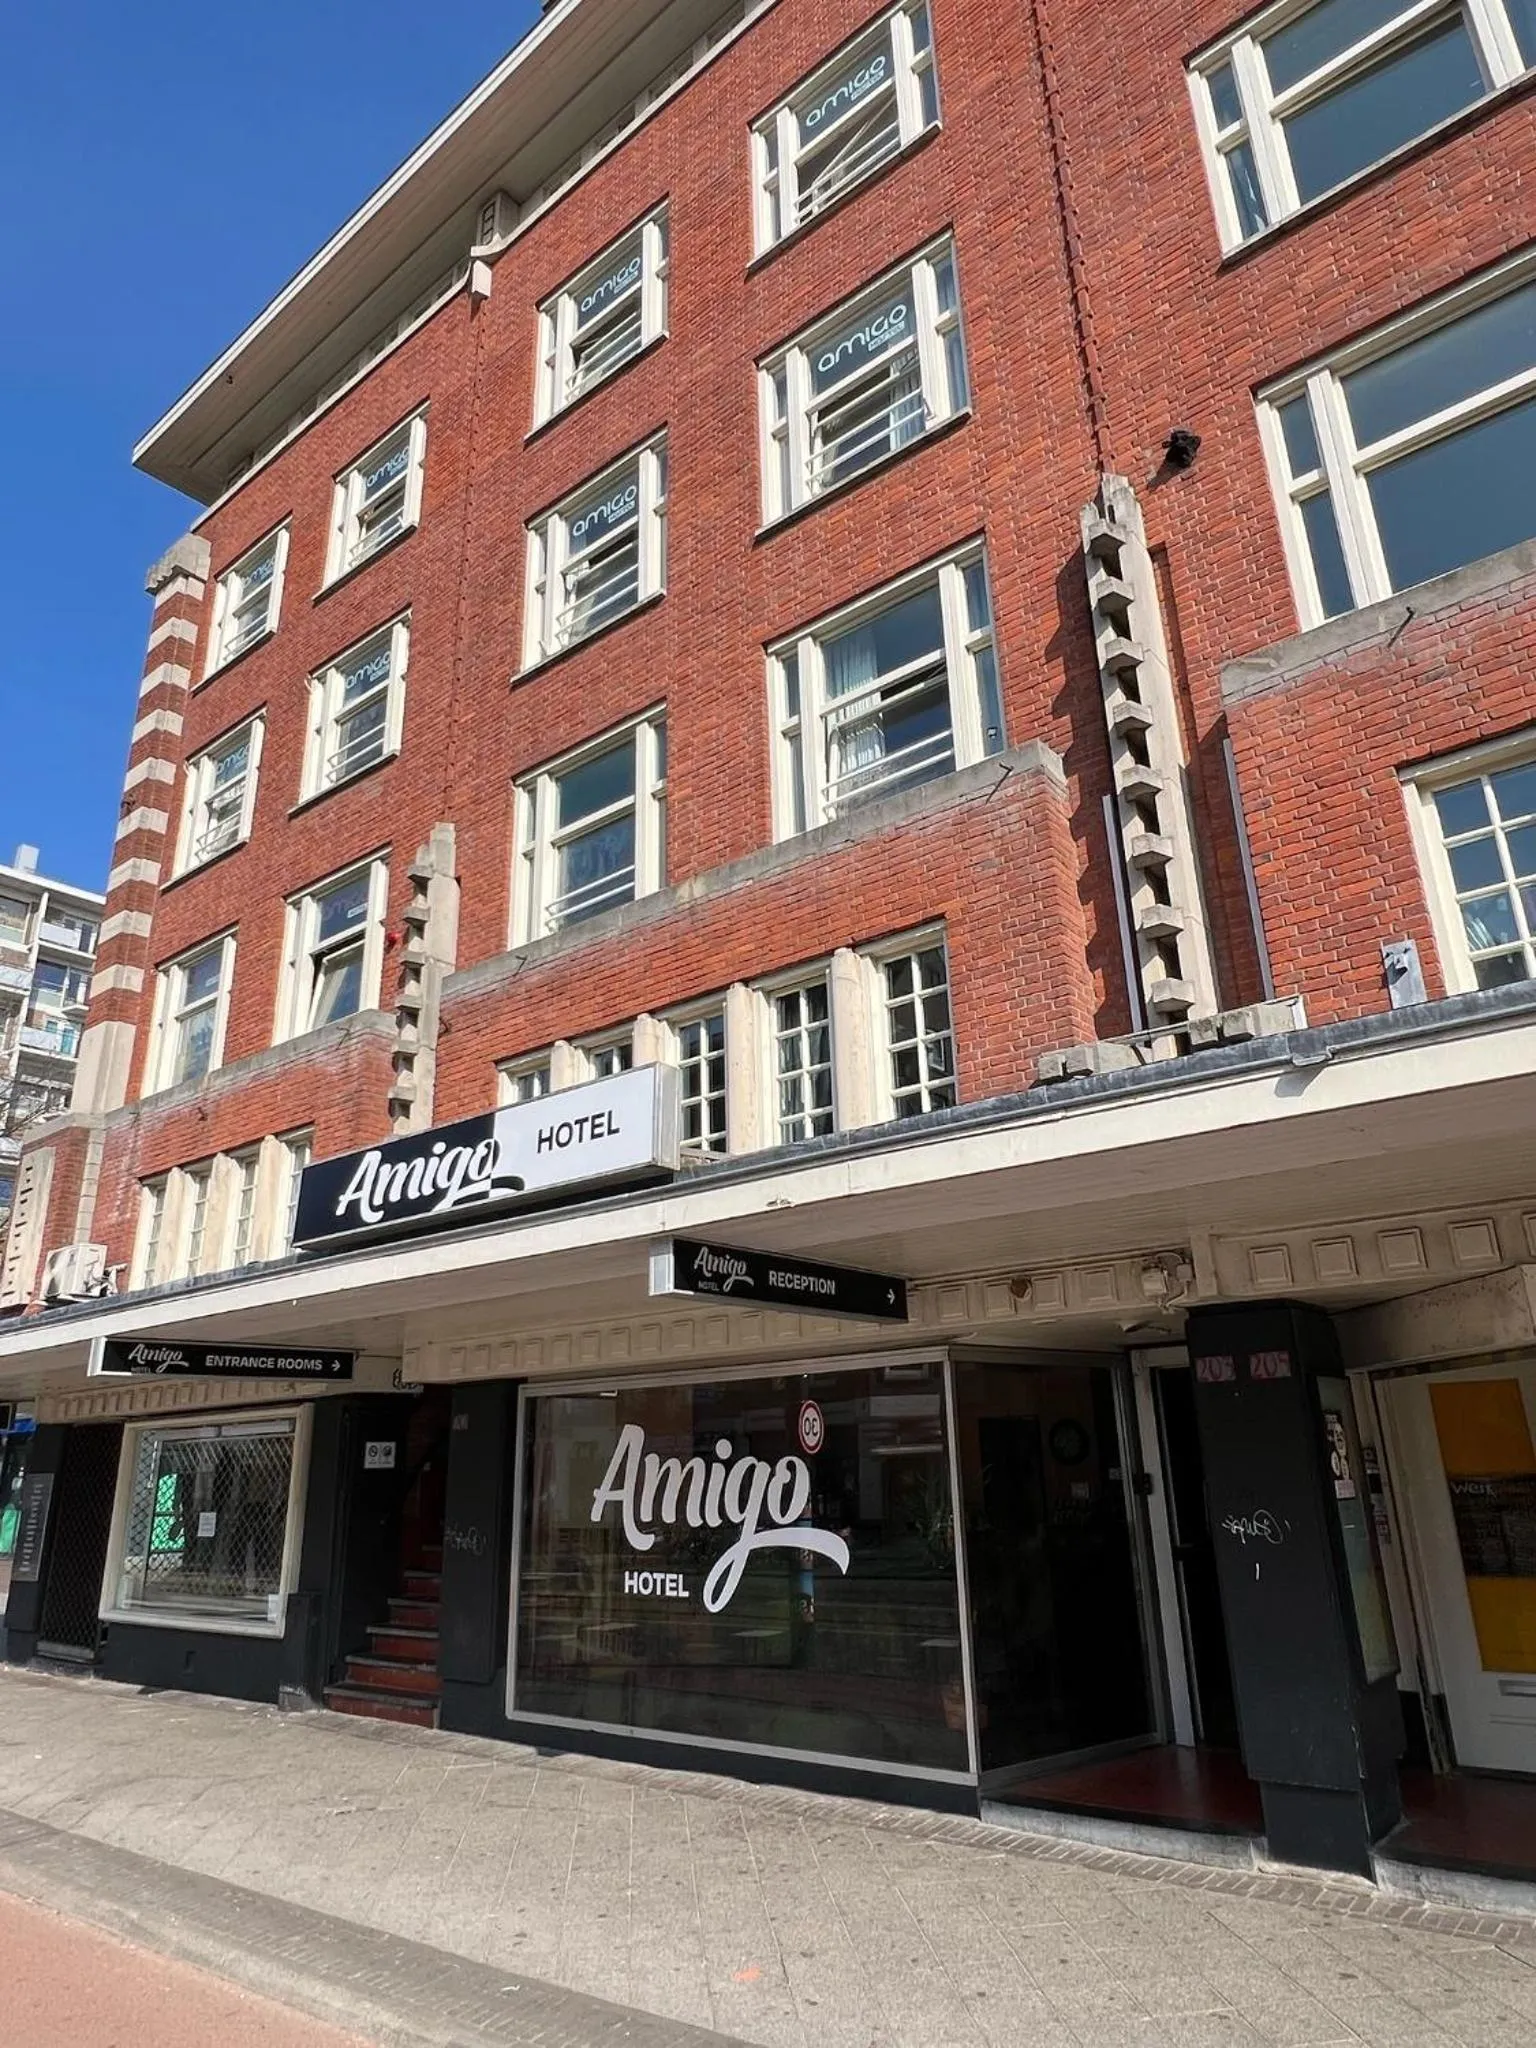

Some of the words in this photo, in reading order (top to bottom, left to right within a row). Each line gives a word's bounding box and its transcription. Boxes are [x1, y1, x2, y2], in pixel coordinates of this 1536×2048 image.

[335, 1137, 526, 1223] Amigo
[536, 1110, 620, 1154] HOTEL
[693, 1246, 754, 1293] Amigo
[768, 1270, 836, 1296] RECEPTION
[128, 1342, 189, 1374] Amigo
[205, 1355, 275, 1370] ENTRANCE
[276, 1358, 323, 1371] ROOMS
[590, 1423, 850, 1614] Amigo
[623, 1570, 690, 1598] HOTEL
